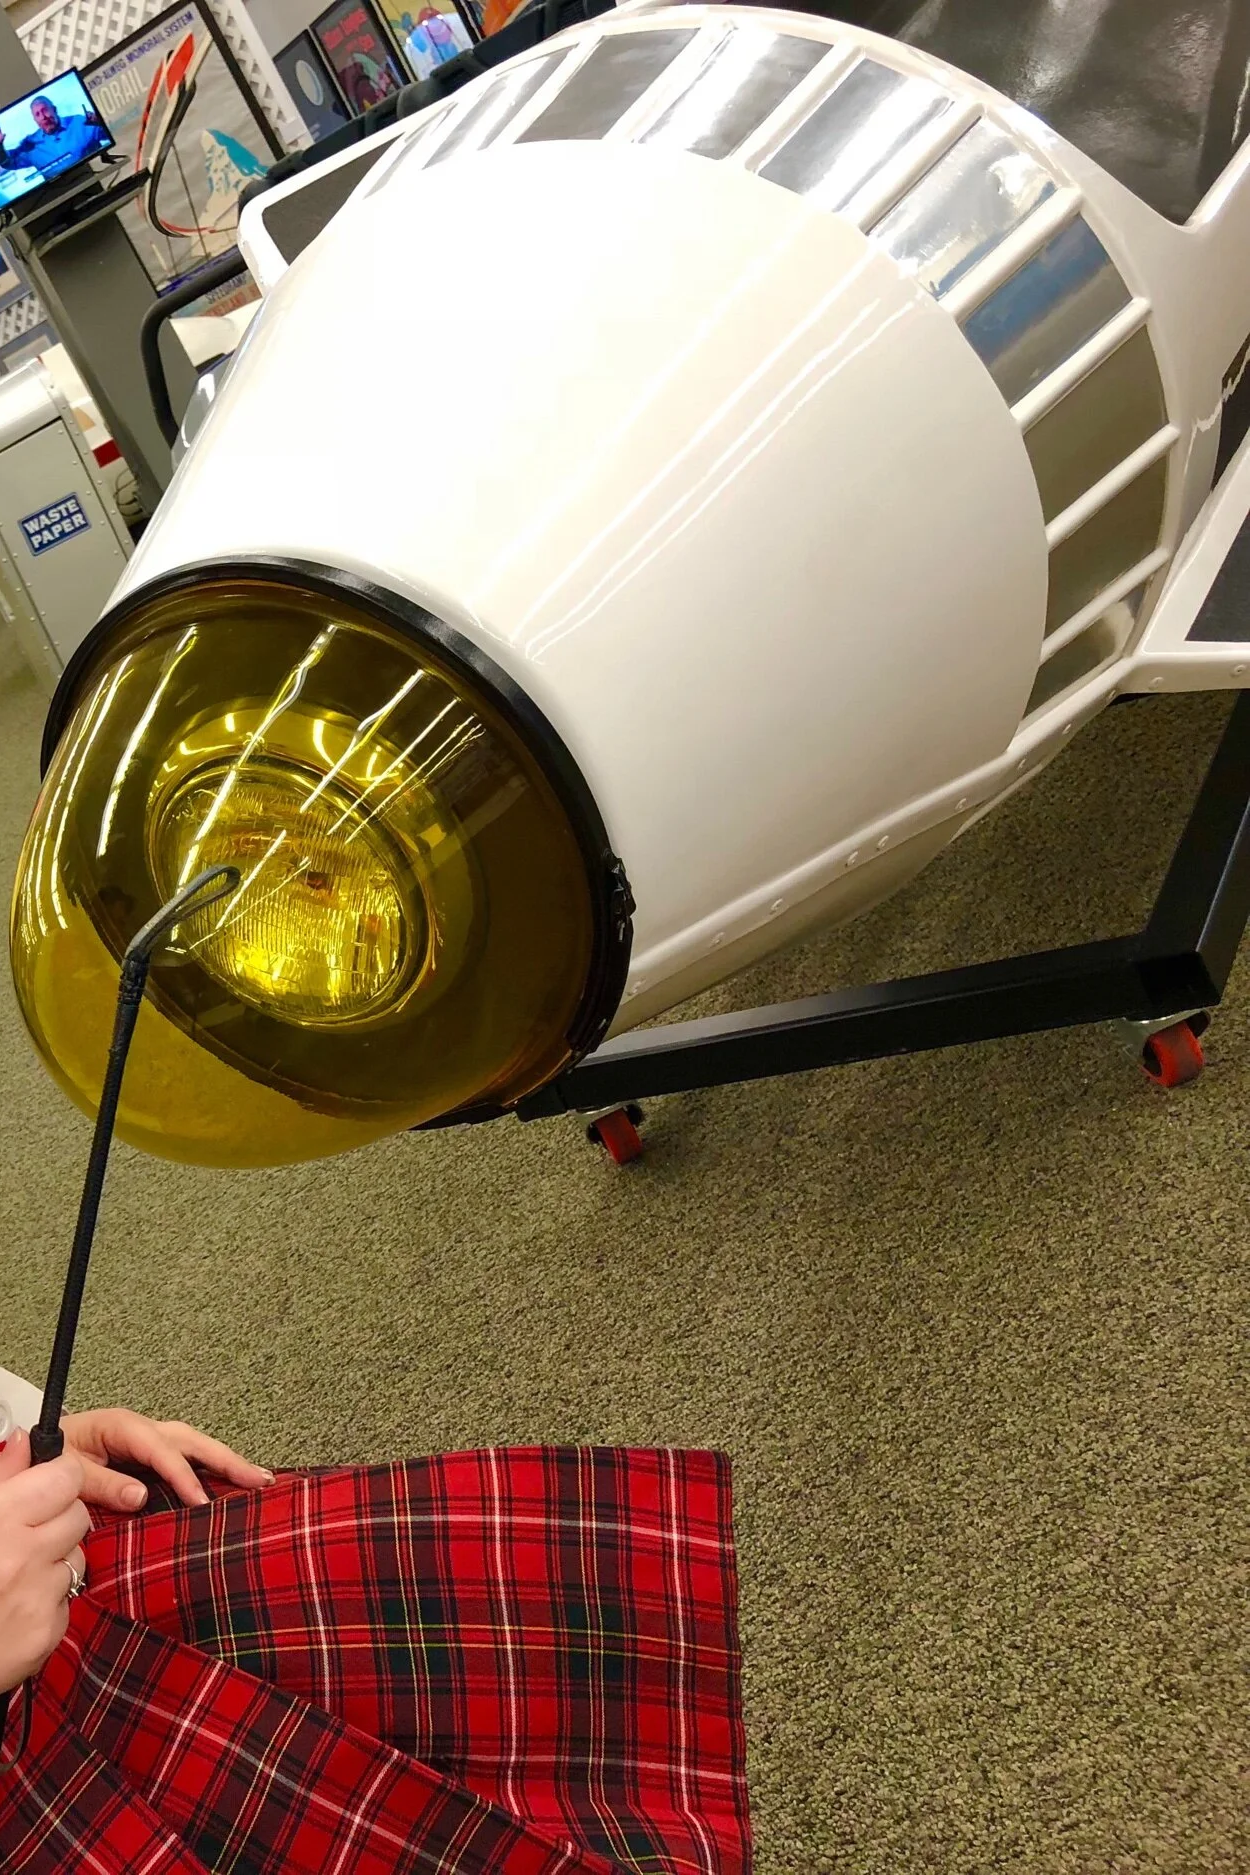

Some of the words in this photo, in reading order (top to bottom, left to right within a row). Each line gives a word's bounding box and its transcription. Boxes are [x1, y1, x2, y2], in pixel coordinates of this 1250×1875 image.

[126, 32, 166, 63] MONORAIL
[164, 10, 194, 37] SYSTEM
[24, 497, 80, 534] WASTE
[30, 512, 87, 549] PAPER
